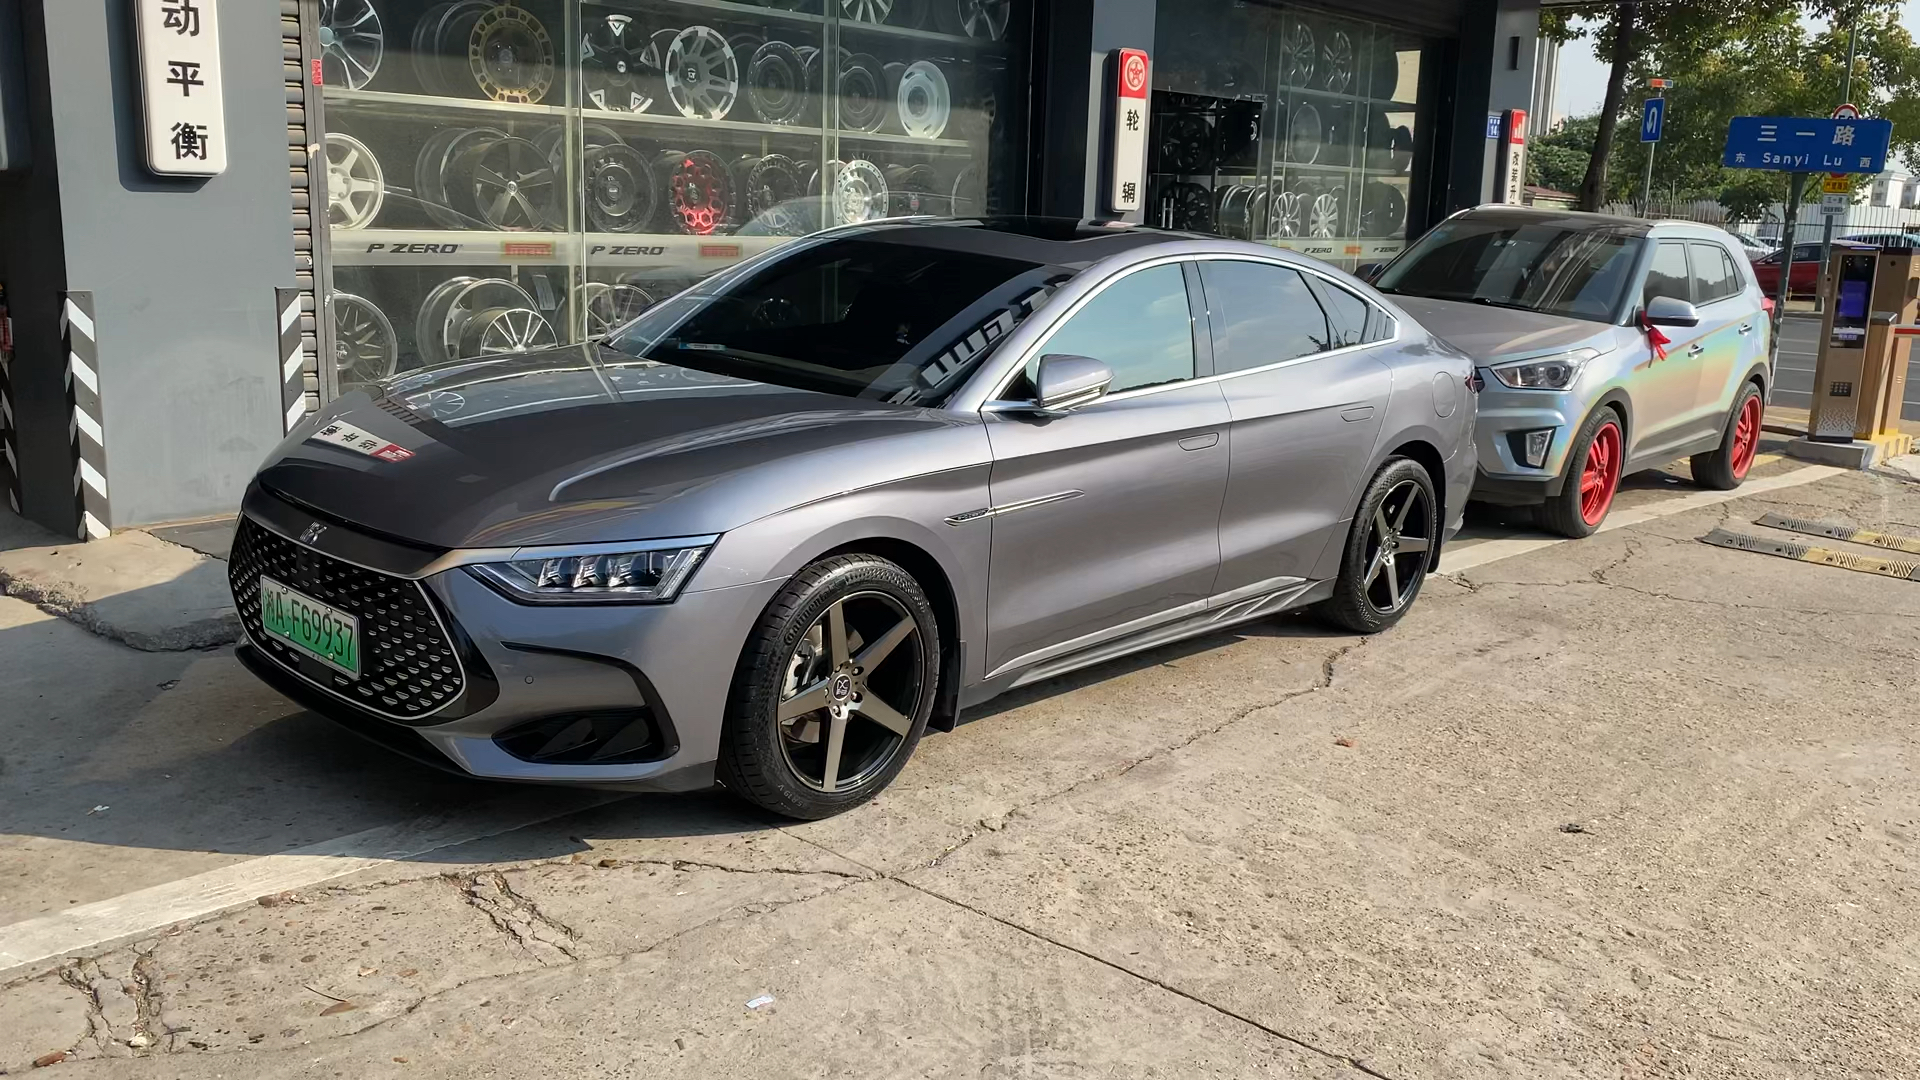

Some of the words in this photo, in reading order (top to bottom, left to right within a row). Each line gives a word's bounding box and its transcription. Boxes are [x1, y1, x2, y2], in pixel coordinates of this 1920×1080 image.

[161, 0, 208, 160] 动平衡
[1757, 124, 1856, 146] 三一路
[1121, 108, 1140, 204] 轮辋
[1735, 152, 1746, 163] 东
[1762, 152, 1810, 167] Sanyi
[1823, 154, 1842, 166] Lu
[1859, 156, 1872, 168] 西
[1509, 151, 1520, 205] 改装升
[366, 243, 385, 254] P
[389, 243, 460, 254] ZERO
[590, 245, 606, 255] P
[609, 245, 666, 256] ZERO
